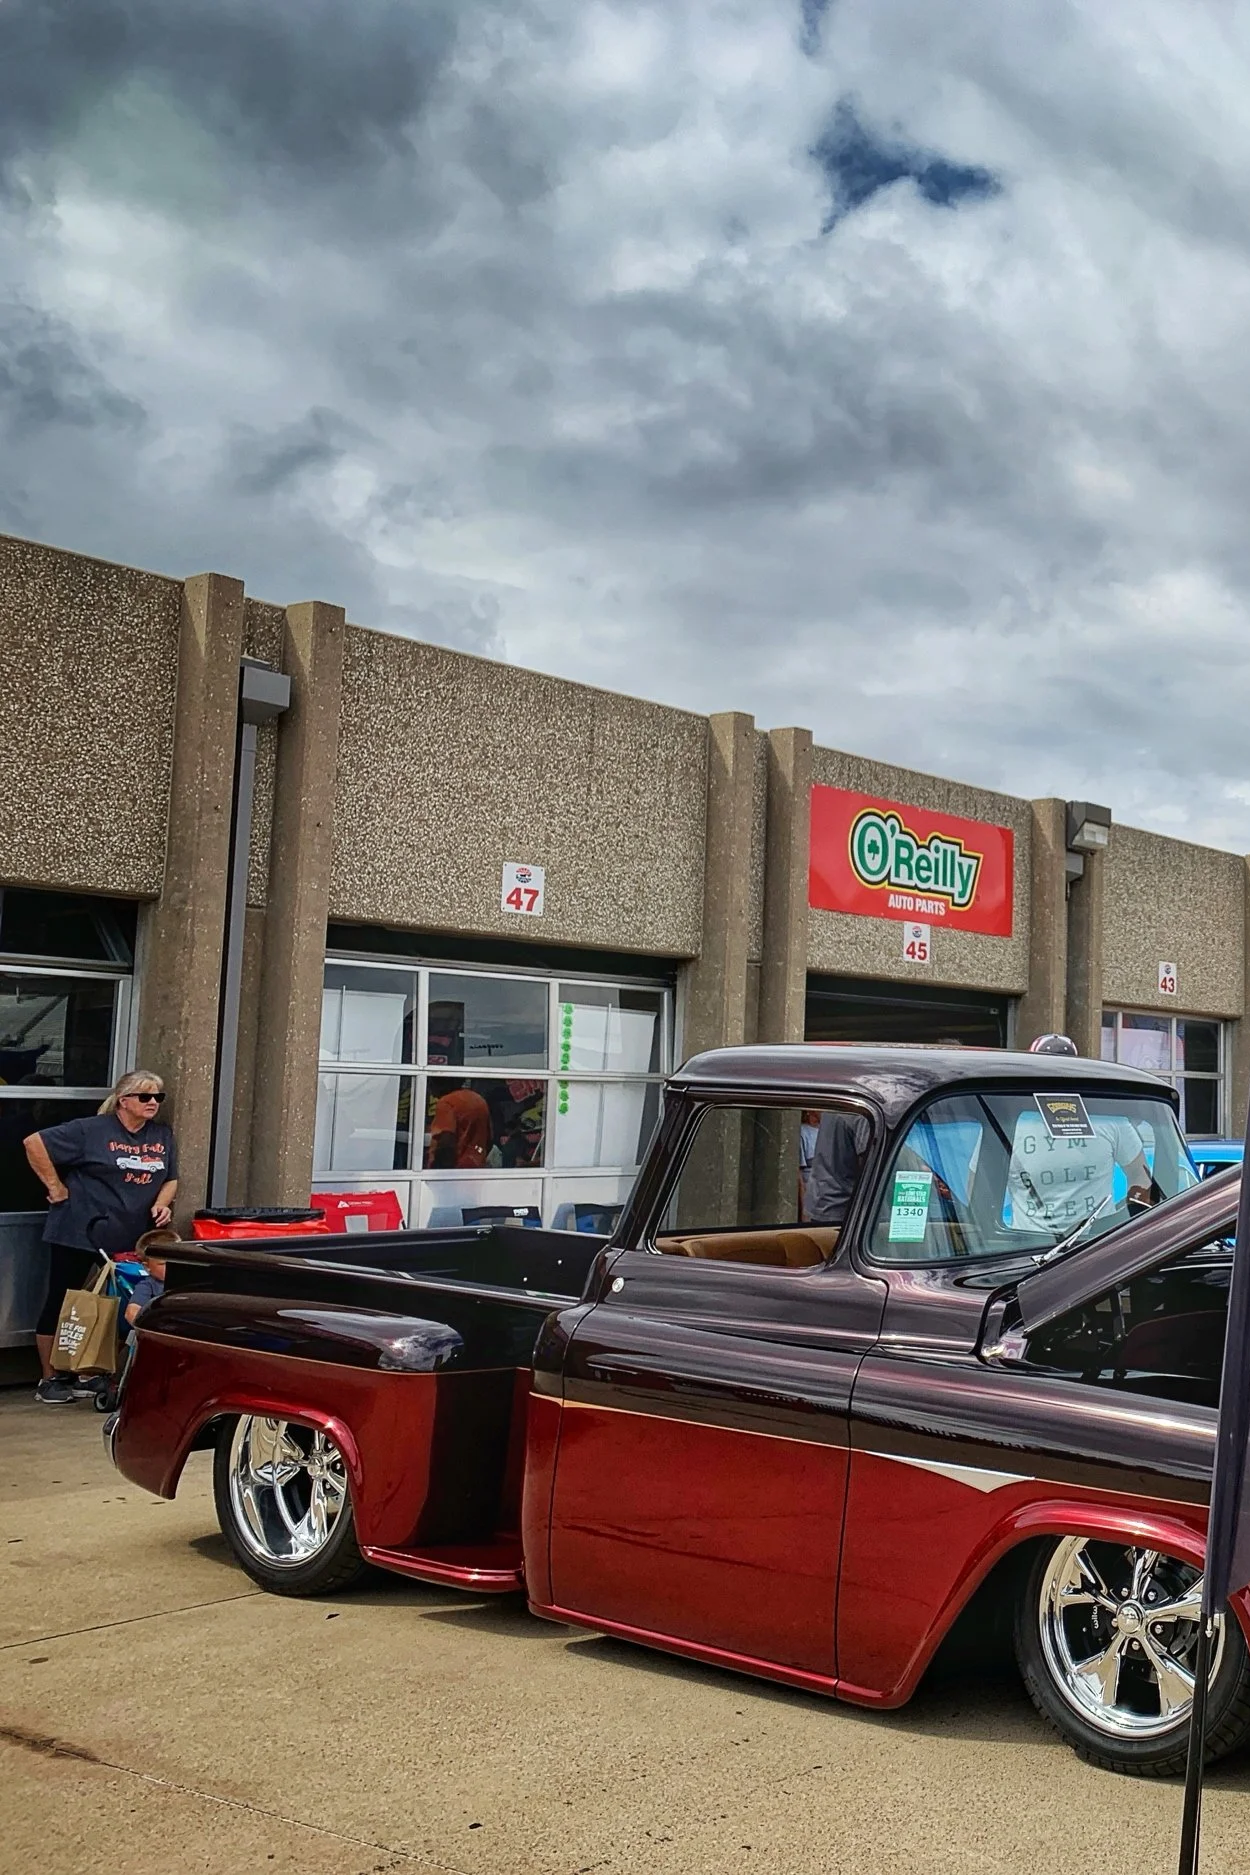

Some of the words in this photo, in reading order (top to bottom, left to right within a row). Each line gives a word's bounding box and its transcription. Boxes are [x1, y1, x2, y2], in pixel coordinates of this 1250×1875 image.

[853, 816, 978, 904] O'Reilly
[506, 887, 539, 912] 47
[888, 893, 914, 911] AUTO
[915, 898, 946, 916] PARTS
[906, 941, 928, 961] 45
[1160, 976, 1175, 993] 43
[1020, 1165, 1097, 1189] GOLF
[896, 1208, 924, 1217] 1340
[1026, 1196, 1096, 1218] BEER
